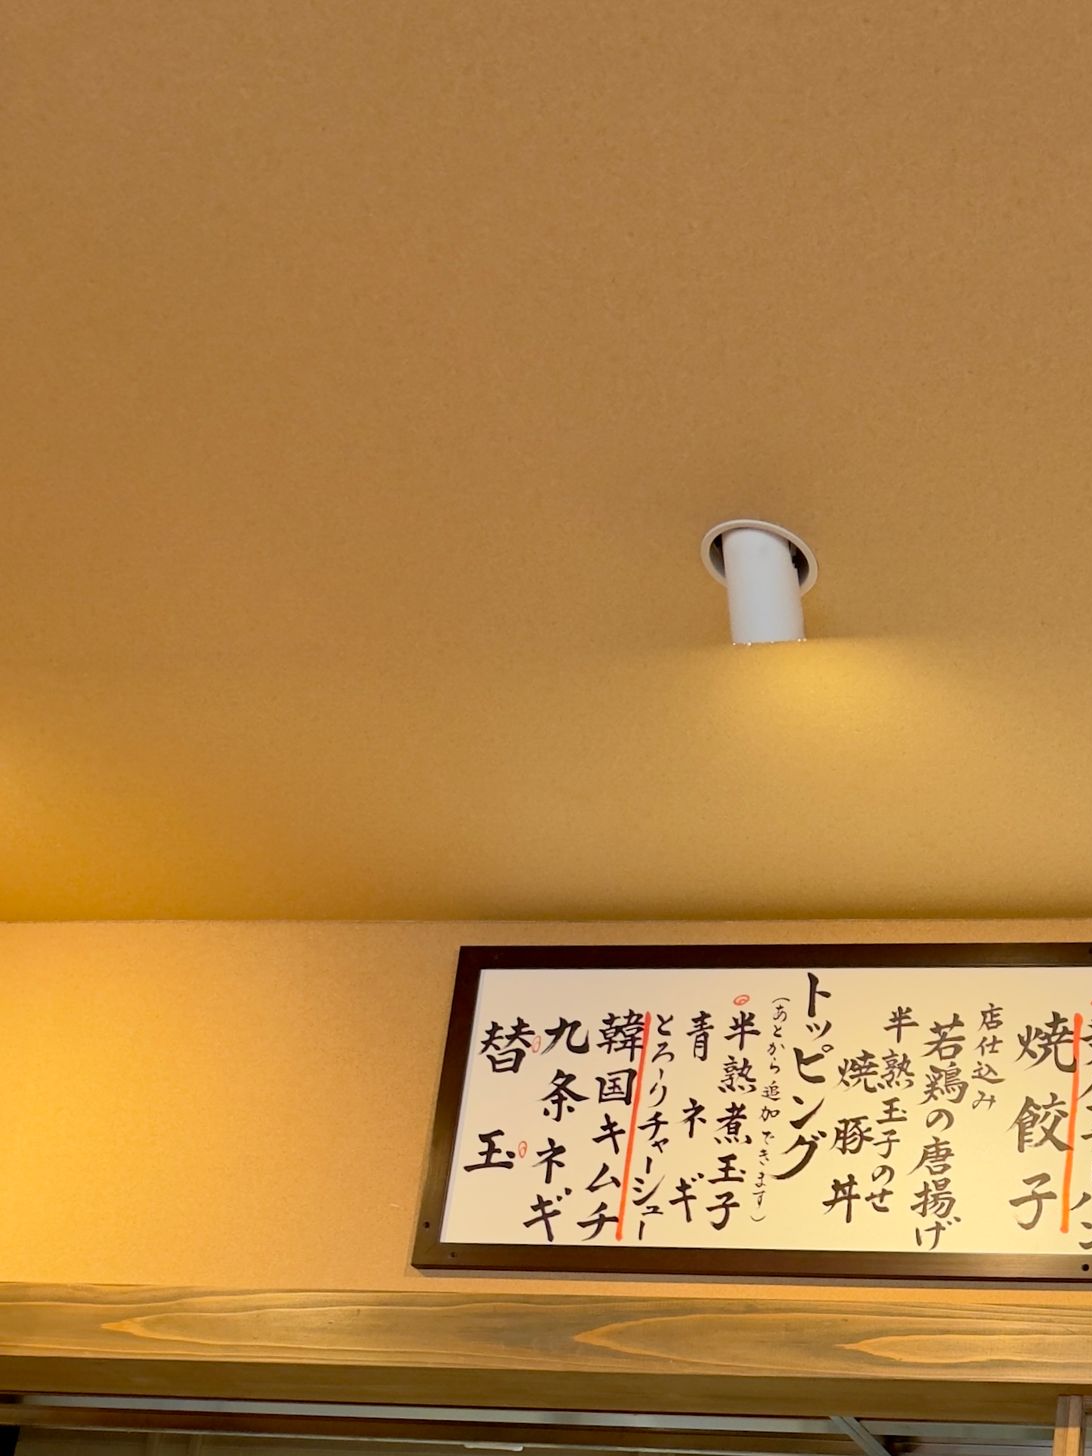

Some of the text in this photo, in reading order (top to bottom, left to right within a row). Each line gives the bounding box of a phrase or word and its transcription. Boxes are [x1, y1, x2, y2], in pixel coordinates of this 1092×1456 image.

[463, 1017, 535, 1176] 替玉
[523, 1017, 591, 1242] 九条ネギ
[577, 1008, 645, 1242] 韓国キムチ
[632, 1013, 676, 1241] とろーりチャーシュー
[669, 1014, 717, 1224] 青ネギ
[706, 1010, 761, 1231] 半熟煮玉子
[775, 971, 833, 1180] トッピング
[822, 1049, 874, 1222] 焼豚丼
[864, 1005, 919, 1213] 半熟玉子のせ
[909, 1020, 970, 1251] 若鶏の唐揚げ
[969, 1002, 1004, 1110] 店仕込み
[1008, 1011, 1077, 1231] 焼餃子
